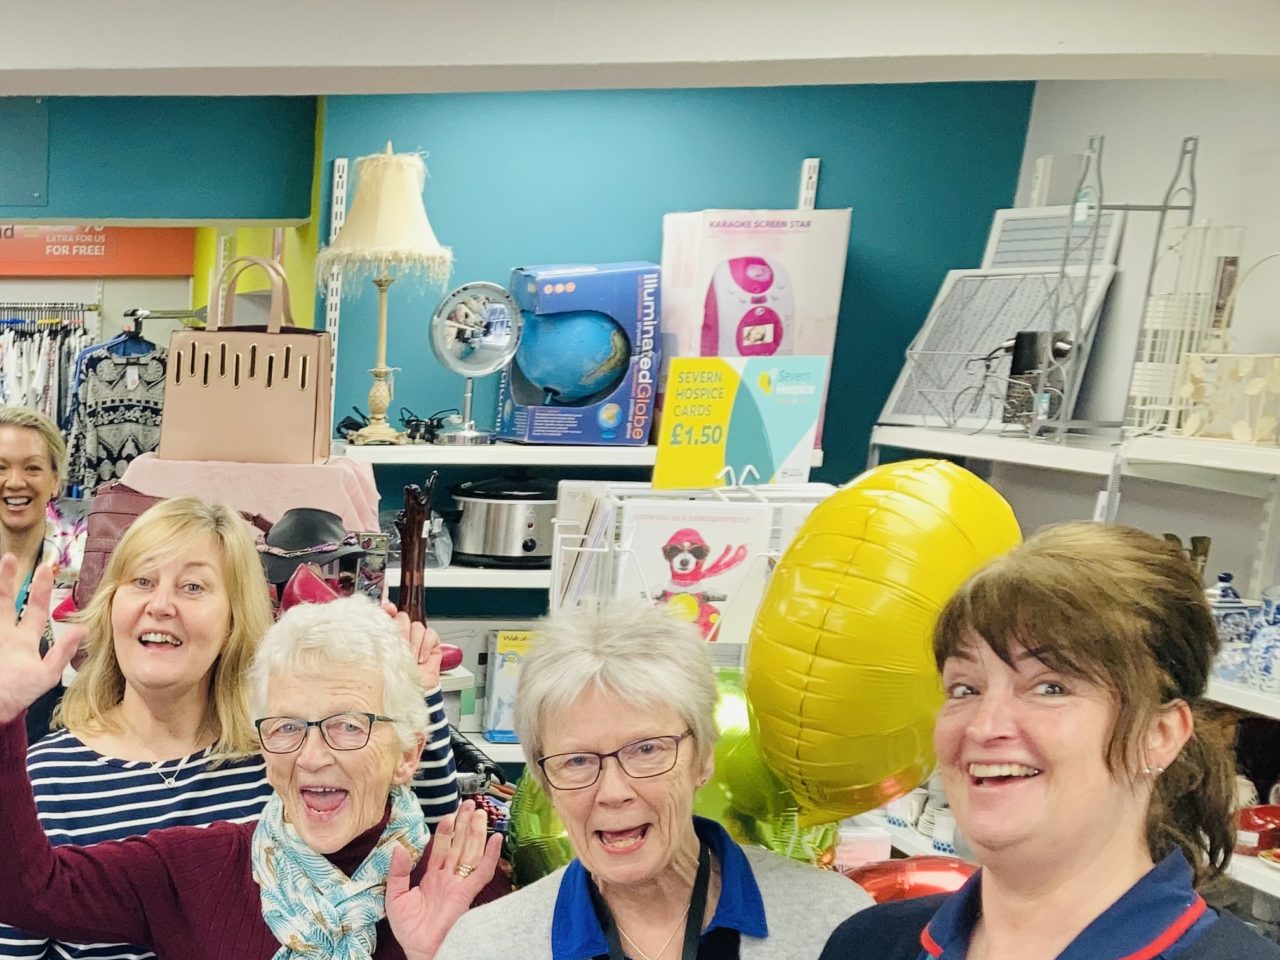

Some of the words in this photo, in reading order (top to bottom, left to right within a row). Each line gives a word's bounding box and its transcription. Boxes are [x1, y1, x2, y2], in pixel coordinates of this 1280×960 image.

[708, 220, 752, 229] KARAOKE
[754, 220, 787, 229] SCREEN
[789, 220, 812, 229] STAR
[46, 234, 73, 243] EXTRA
[75, 235, 93, 243] FOR
[94, 235, 106, 243] US
[46, 245, 69, 256] FOR
[72, 245, 105, 256] FREE!
[678, 371, 723, 384] SEVERN
[676, 387, 725, 400] HOSPICE
[673, 404, 712, 417] CARDS
[669, 422, 723, 446] £1.50
